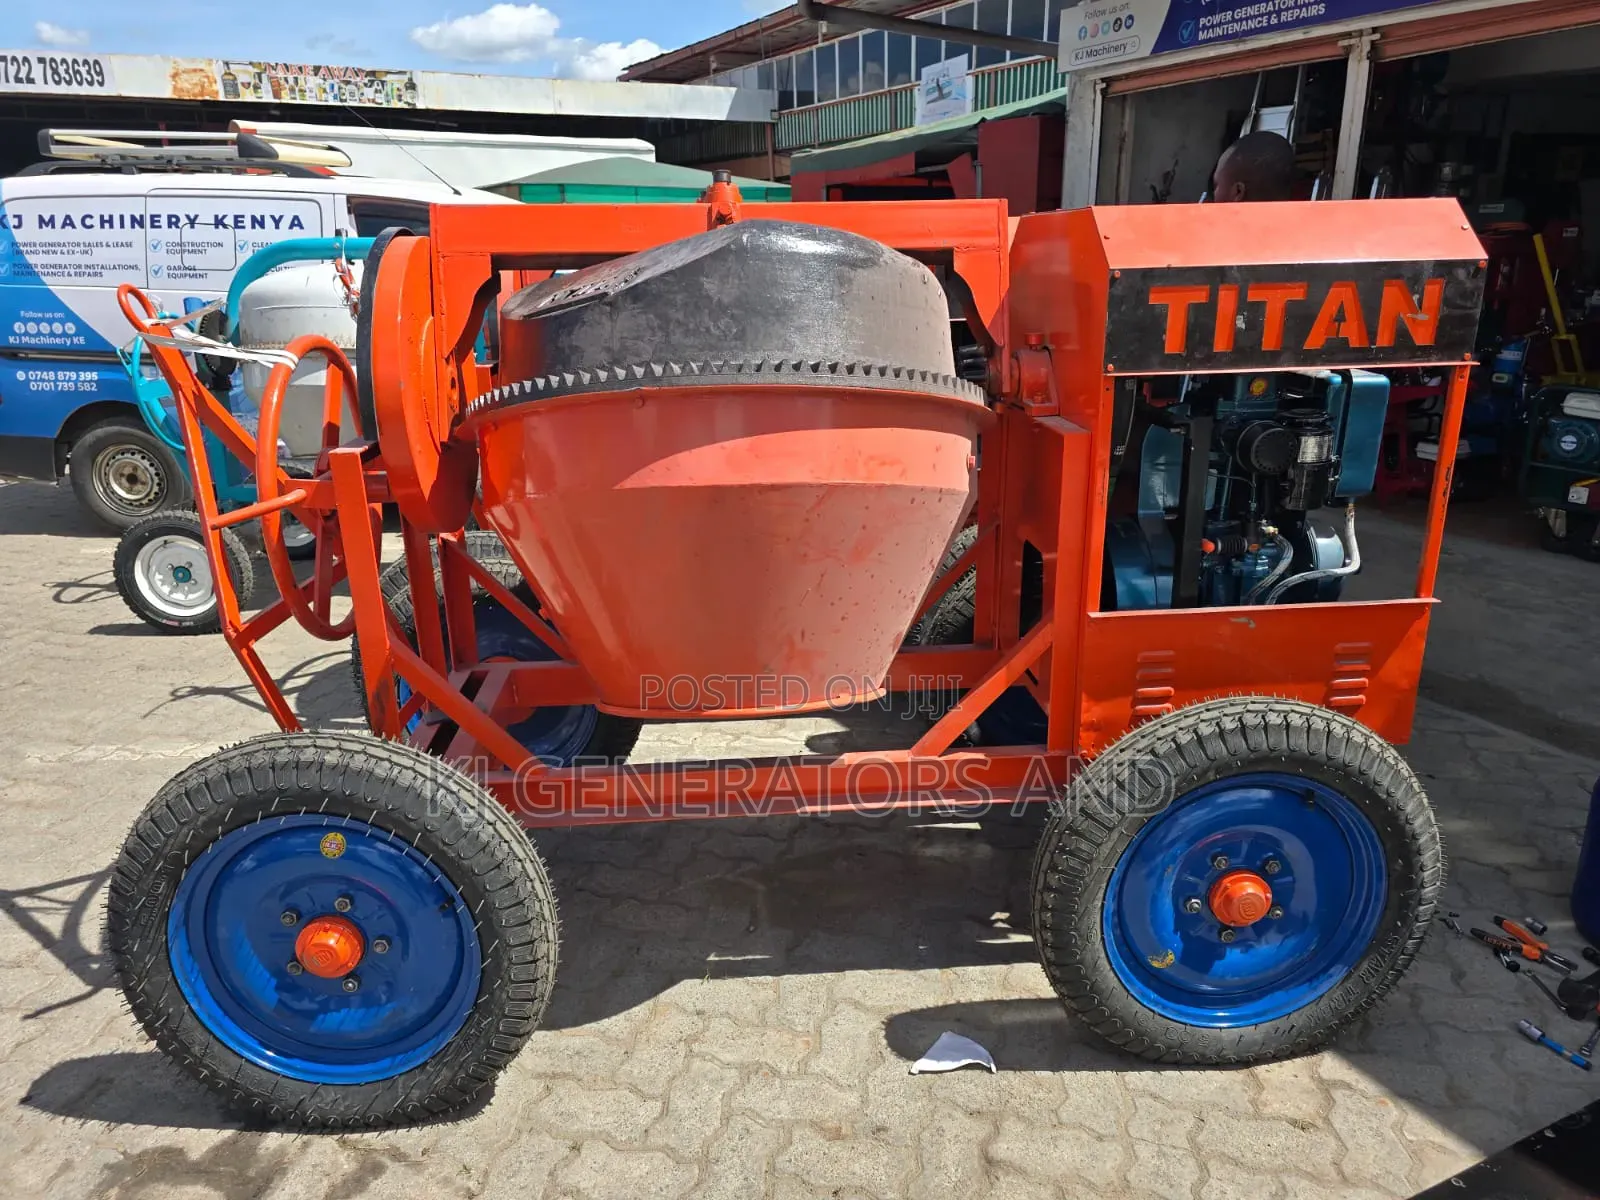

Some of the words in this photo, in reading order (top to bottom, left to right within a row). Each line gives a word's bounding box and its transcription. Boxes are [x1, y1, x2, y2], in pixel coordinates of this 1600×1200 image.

[1084, 8, 1107, 20] Follow
[1109, 6, 1118, 14] us
[1199, 10, 1233, 28] POWER
[1234, 0, 1295, 20] GENERATOR
[1198, 15, 1269, 41] MAINTENANCE
[1270, 13, 1279, 25] &
[1280, 3, 1326, 23] REPAIRS
[1074, 50, 1084, 61] KJ
[1085, 42, 1128, 58] Machinery
[37, 56, 105, 87] 783639
[319, 65, 366, 81] AWAY
[38, 213, 199, 230] MACHINERY
[214, 214, 305, 230] KENYA
[11, 241, 37, 249] POWER
[38, 241, 81, 249] GENERATOR
[82, 241, 104, 249] SALES
[112, 241, 133, 249] LEASE
[165, 241, 224, 249] CONSTRUCTION
[66, 248, 93, 257] EX-UK)
[166, 248, 208, 256] EQUIPMENT
[84, 263, 141, 272] INSTALLATIONS,
[166, 264, 197, 272] GARAGE
[13, 270, 66, 278] MAINTENANCE
[74, 270, 103, 278] REPAIRS
[167, 272, 209, 280] EQUIPMENT
[20, 310, 43, 319] Follow
[1148, 278, 1444, 354] TITAN
[8, 336, 20, 345] KJ
[21, 335, 71, 347] Machinery
[72, 336, 86, 345] KE
[28, 371, 56, 381] 0748
[57, 371, 77, 381] 879
[78, 371, 99, 381] 395
[30, 382, 56, 391] 0701
[57, 382, 75, 391] 739
[77, 382, 98, 391] 582
